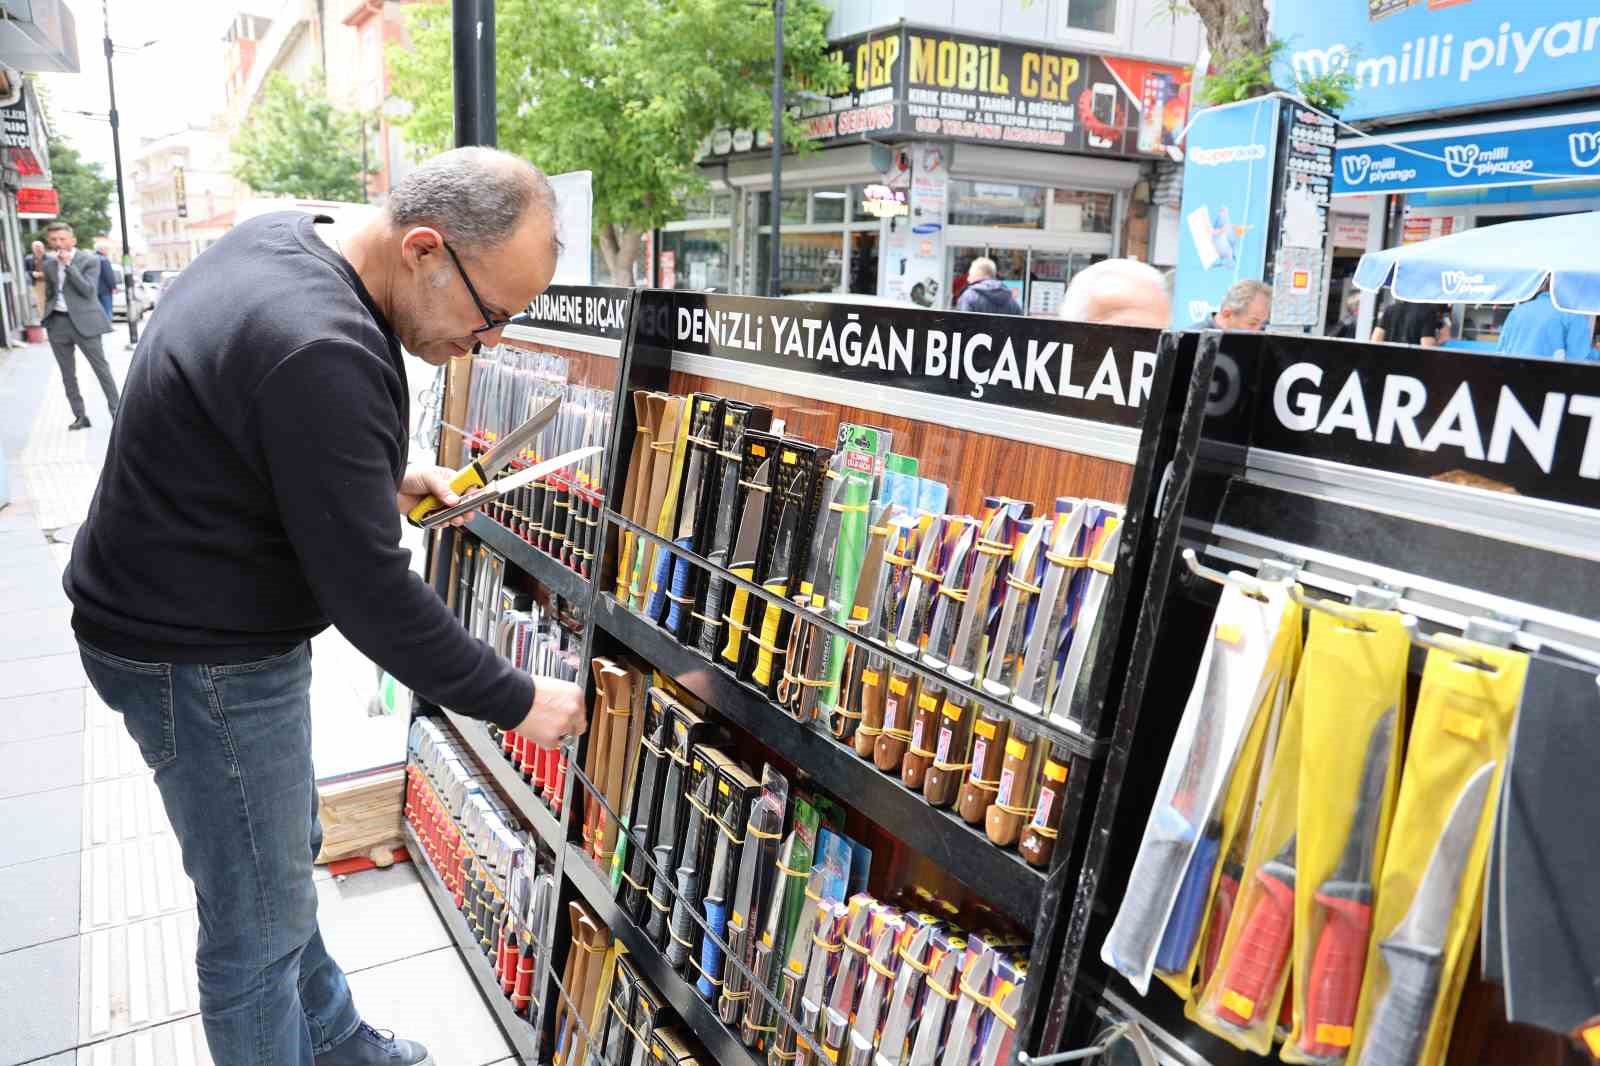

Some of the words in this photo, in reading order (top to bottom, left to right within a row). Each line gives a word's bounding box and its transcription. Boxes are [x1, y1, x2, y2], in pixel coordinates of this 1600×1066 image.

[856, 35, 899, 90] CEP
[1020, 52, 1080, 101] CEP
[1355, 33, 1454, 90] milli
[1370, 157, 1396, 170] milli
[1477, 159, 1533, 176] piyango
[1478, 146, 1509, 160] milli
[1369, 169, 1416, 183] piyango
[585, 297, 628, 333] BIÇAK
[770, 313, 914, 375] YATAĞAN
[924, 329, 1157, 408] BIÇAKLAR
